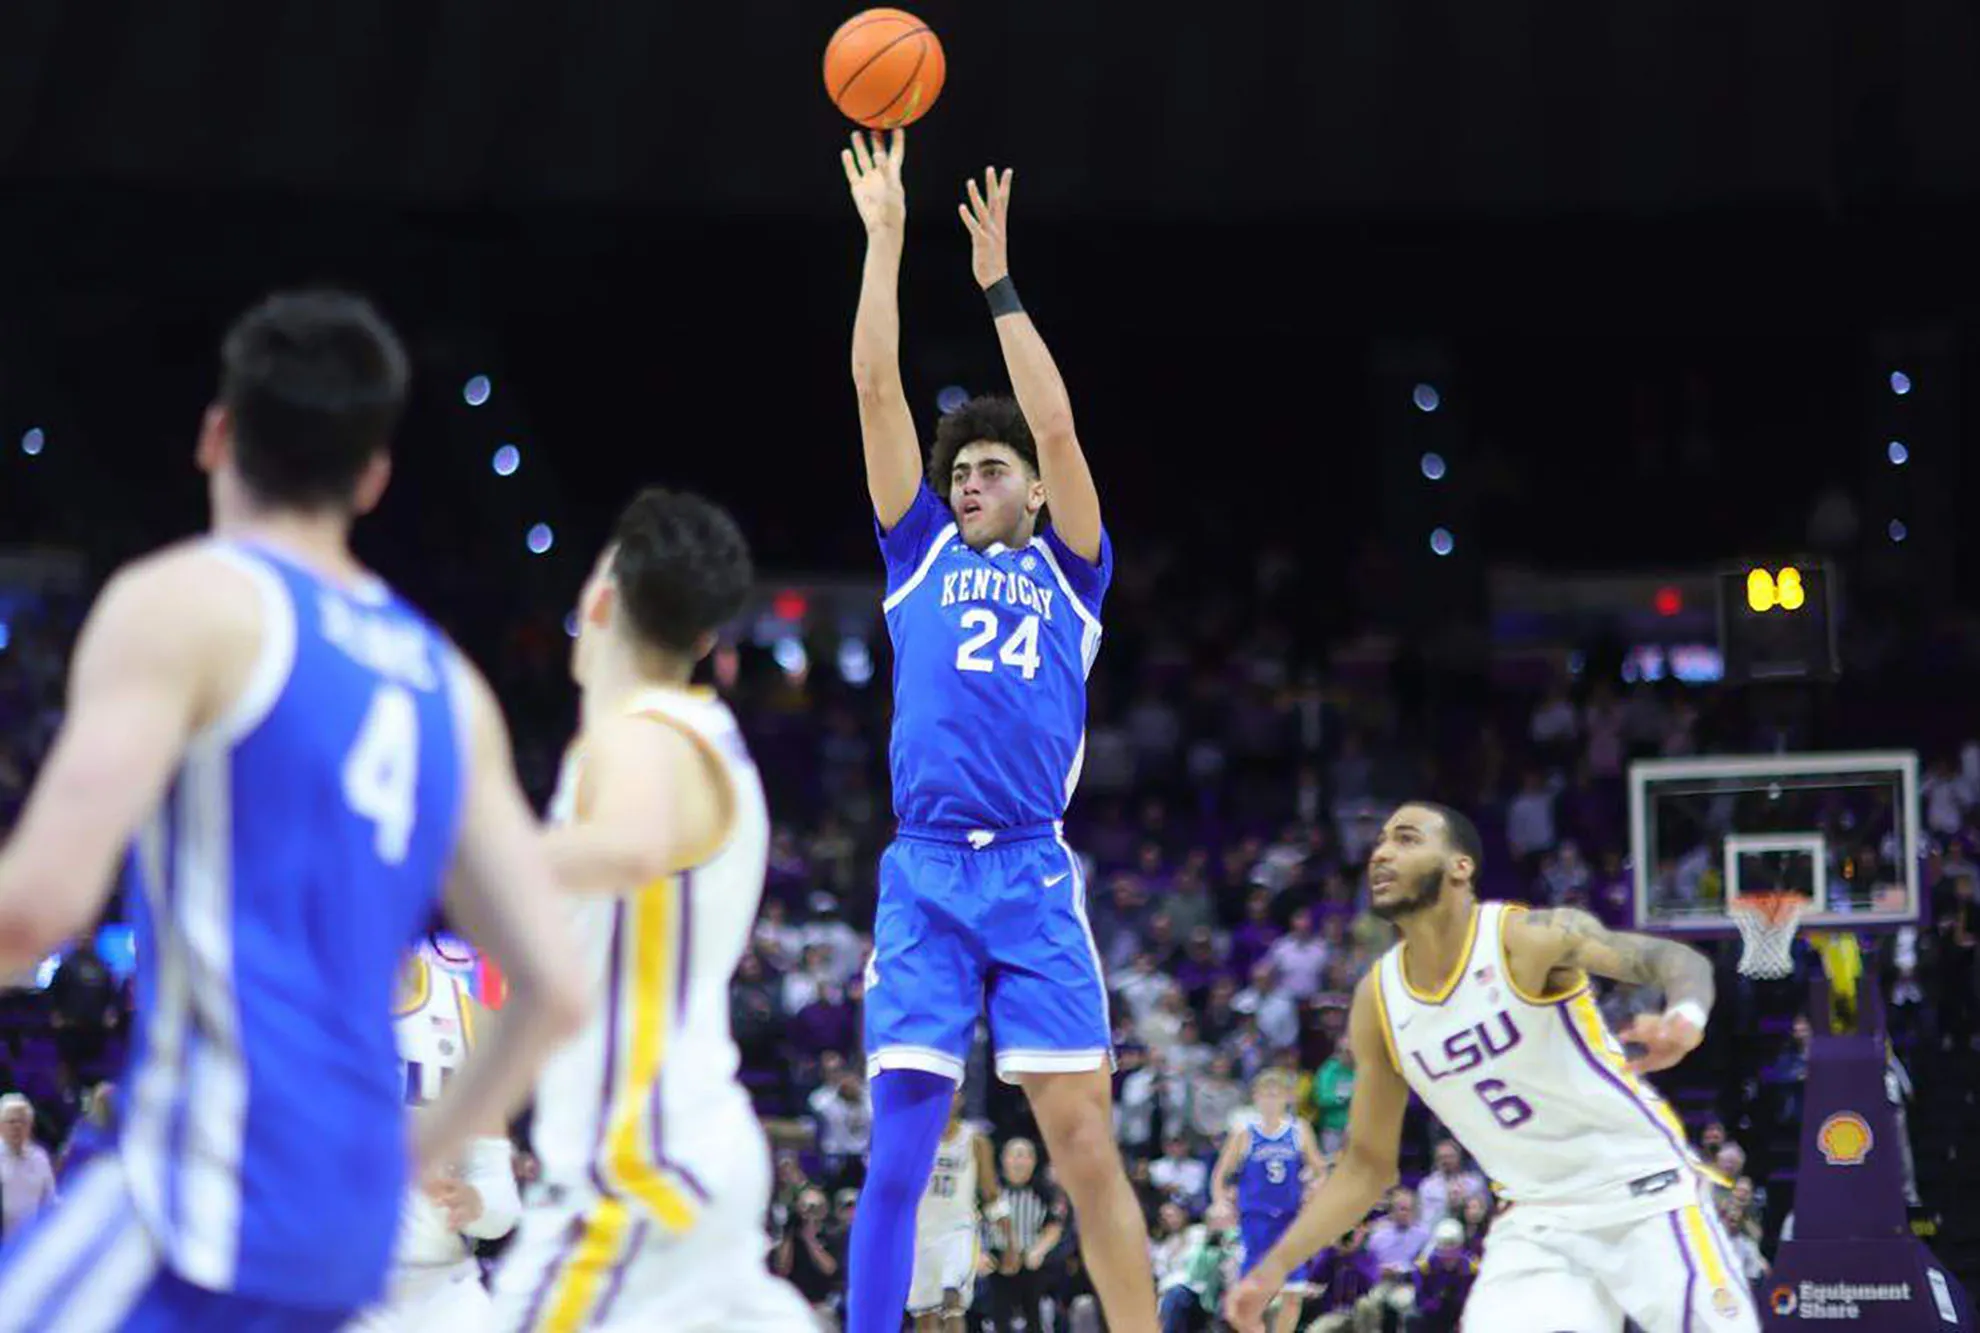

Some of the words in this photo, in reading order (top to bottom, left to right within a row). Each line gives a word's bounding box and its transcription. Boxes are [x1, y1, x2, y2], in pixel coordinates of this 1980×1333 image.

[956, 608, 1041, 681] 24
[341, 684, 420, 866] 4
[1412, 1010, 1522, 1082] LSU
[1474, 1078, 1533, 1129] 6
[1799, 1281, 1911, 1302] Equipment
[1799, 1302, 1859, 1319] Share
